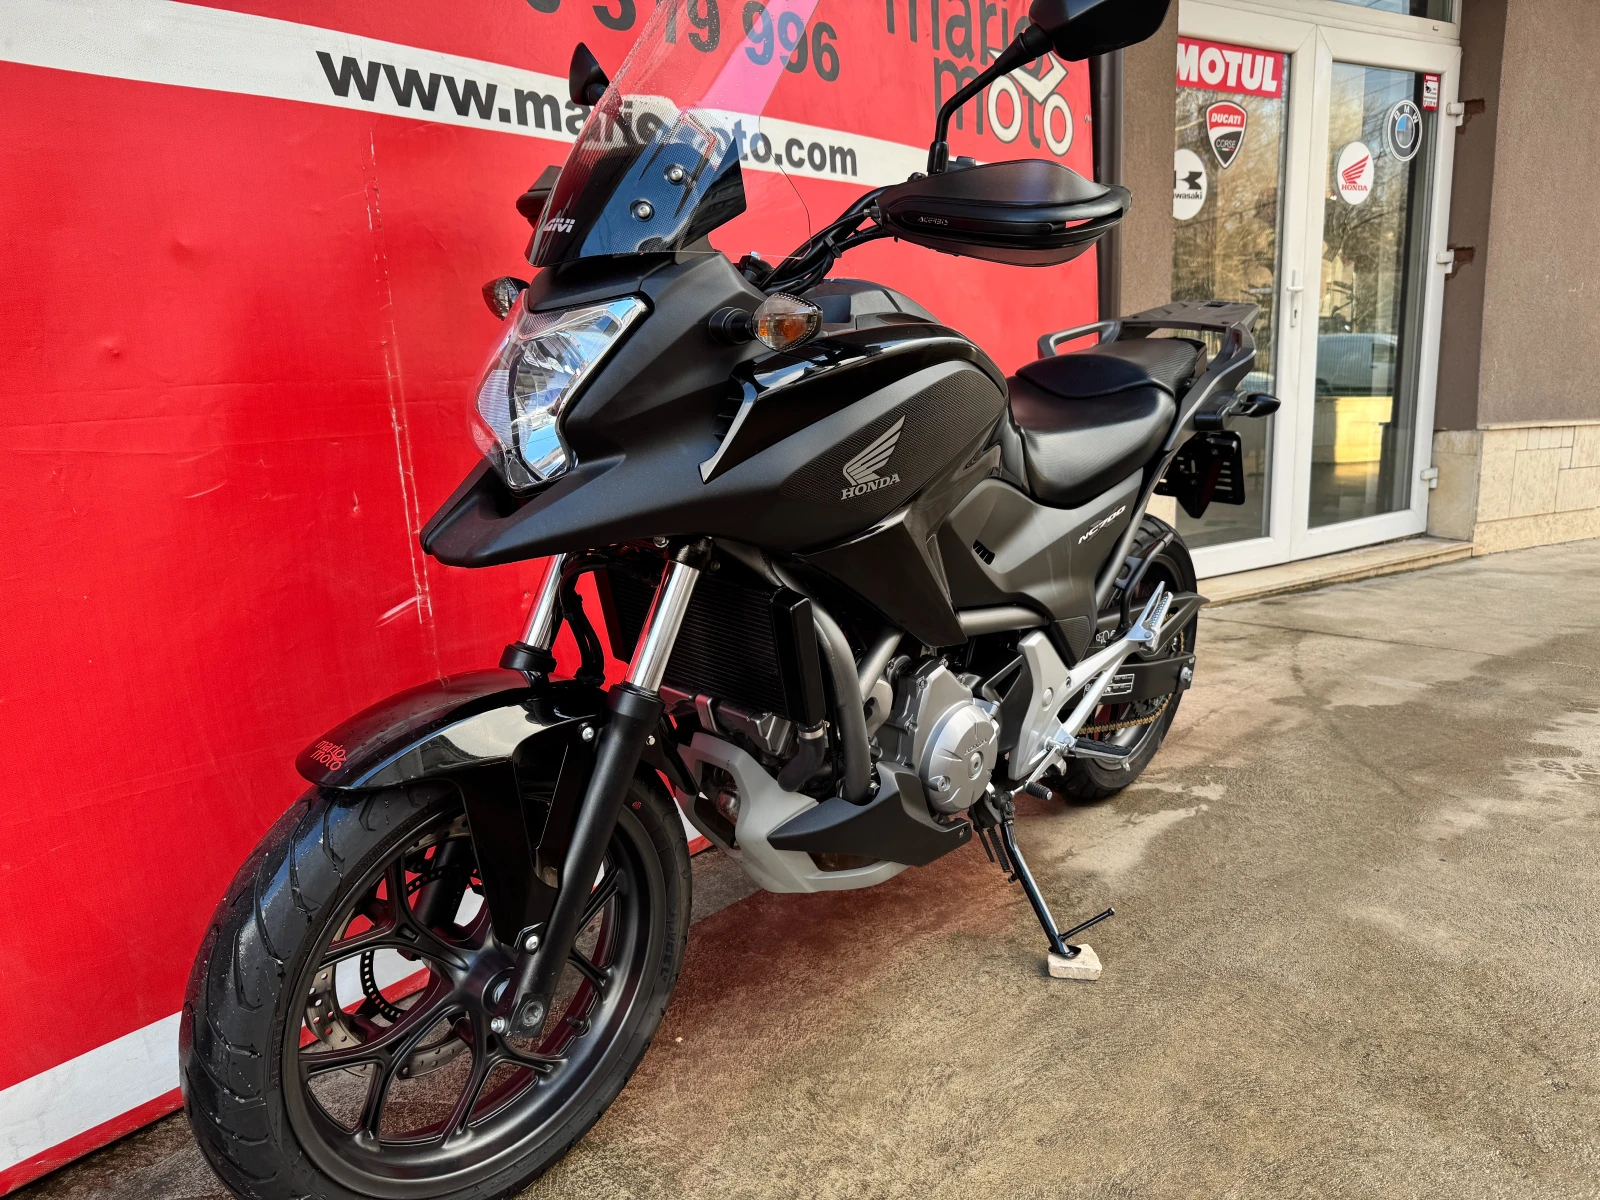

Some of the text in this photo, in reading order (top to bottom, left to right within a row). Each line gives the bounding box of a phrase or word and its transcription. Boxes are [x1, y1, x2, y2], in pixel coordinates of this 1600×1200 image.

[742, 1, 840, 82] 996
[1176, 43, 1278, 92] MOTUL
[1211, 112, 1242, 125] DUCATI
[1394, 104, 1419, 124] BMW
[1215, 139, 1237, 149] CORSE
[1173, 191, 1203, 200] wasaki
[1341, 183, 1369, 192] HONDA
[543, 217, 576, 233] GIVI
[840, 473, 901, 500] HONDA
[315, 740, 346, 758] mario
[310, 749, 343, 771] moto
